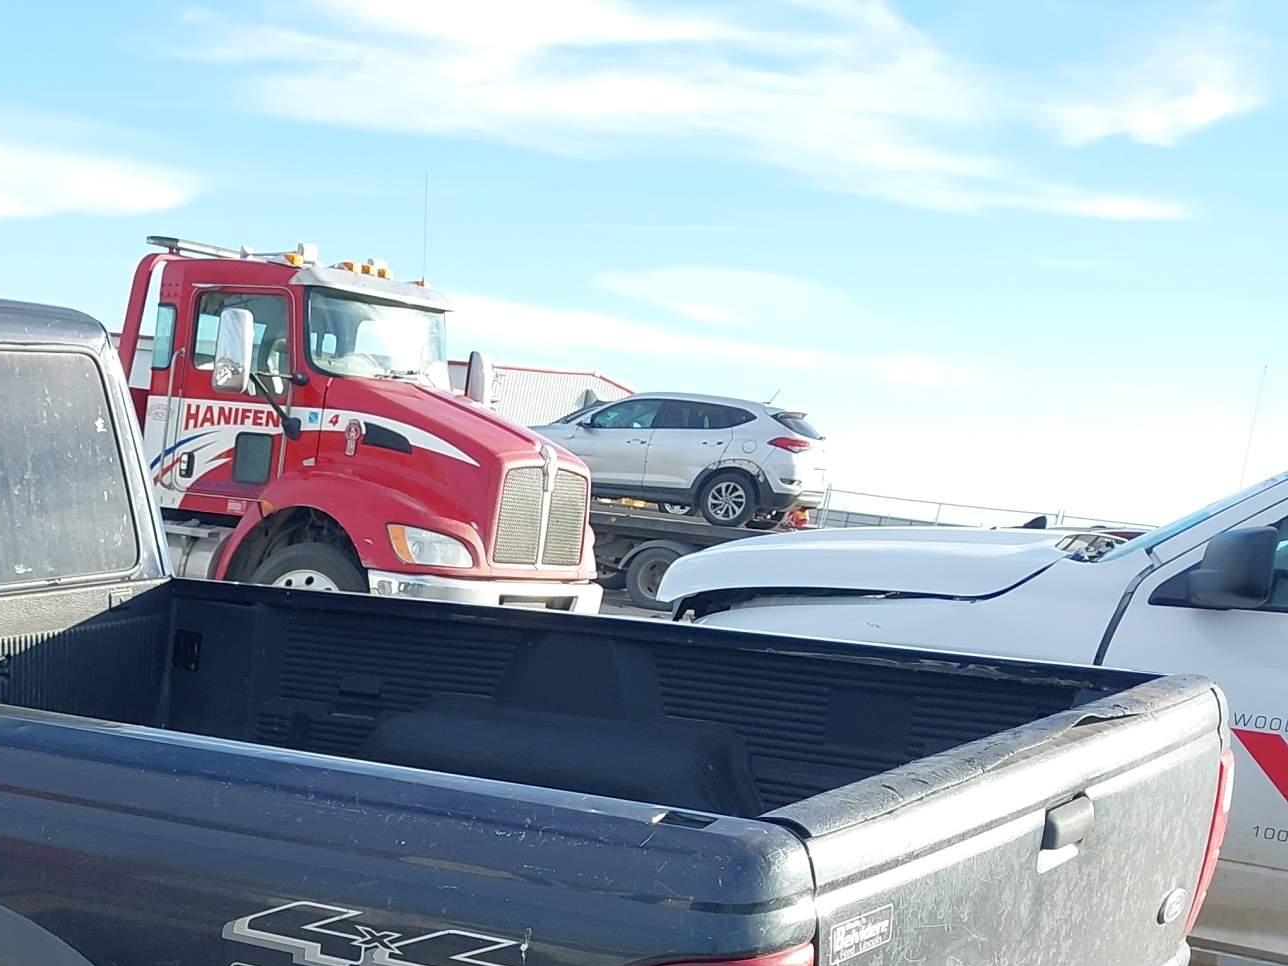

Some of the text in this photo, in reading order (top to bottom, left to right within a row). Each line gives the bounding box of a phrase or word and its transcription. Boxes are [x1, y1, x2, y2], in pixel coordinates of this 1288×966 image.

[184, 403, 281, 431] HANIFEN
[328, 414, 340, 427] 4
[1234, 711, 1288, 733] WOO
